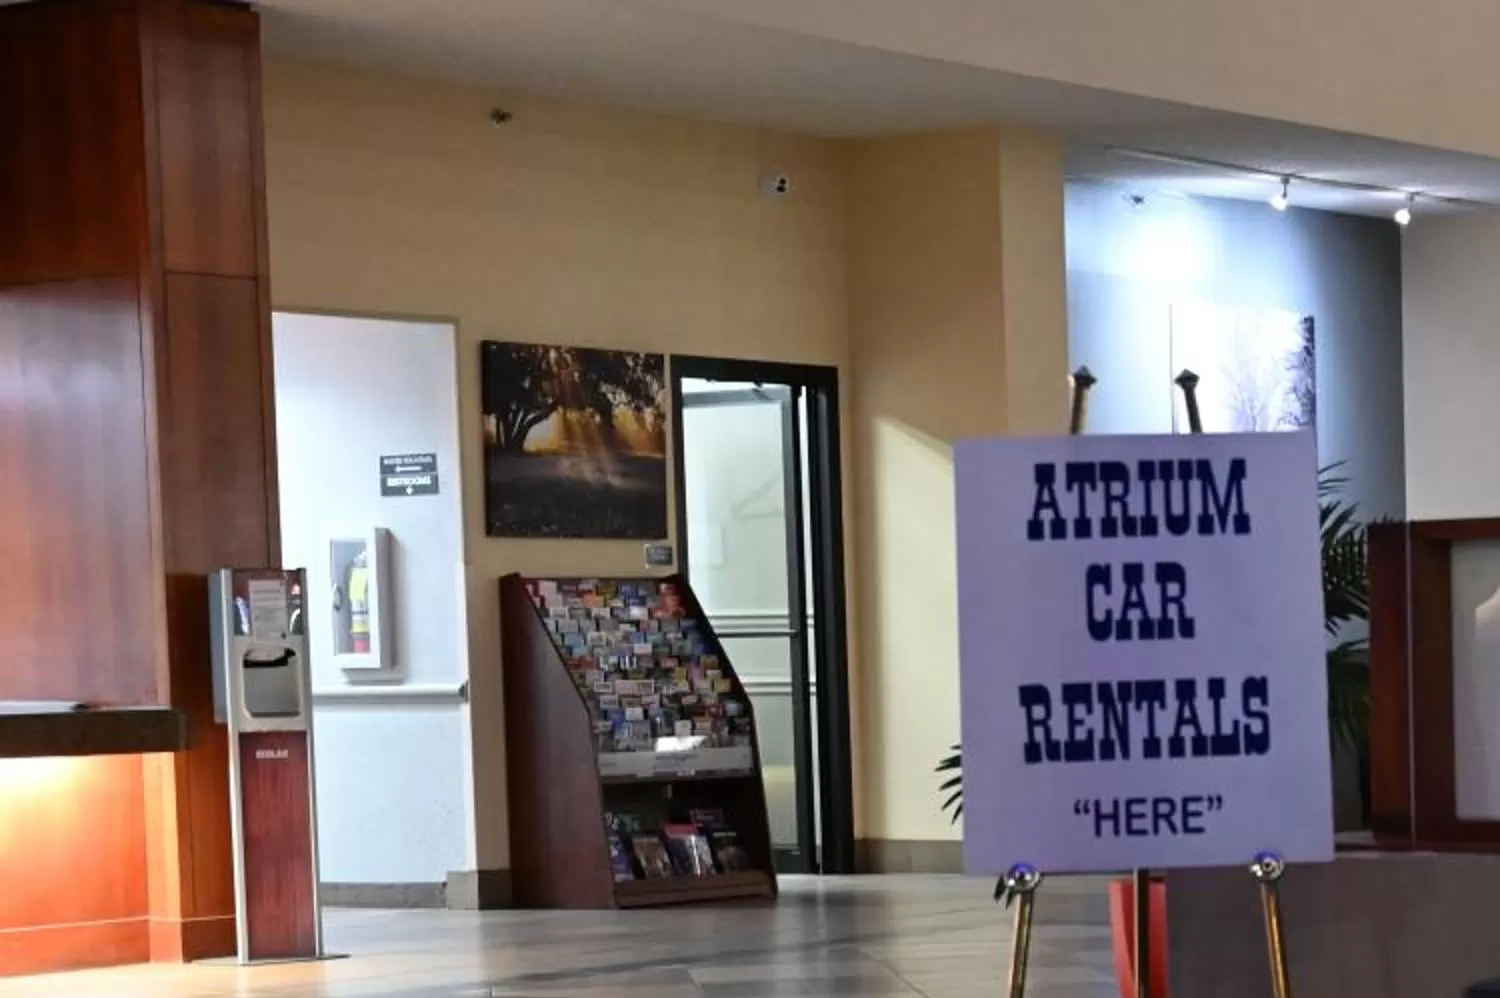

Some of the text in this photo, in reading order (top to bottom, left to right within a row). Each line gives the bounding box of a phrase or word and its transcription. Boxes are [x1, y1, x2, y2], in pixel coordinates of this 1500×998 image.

[1026, 457, 1252, 541] ATRIUM
[1085, 561, 1196, 642] CAR
[1017, 675, 1271, 765] RENTALS
[1073, 794, 1223, 838] “HERE”
